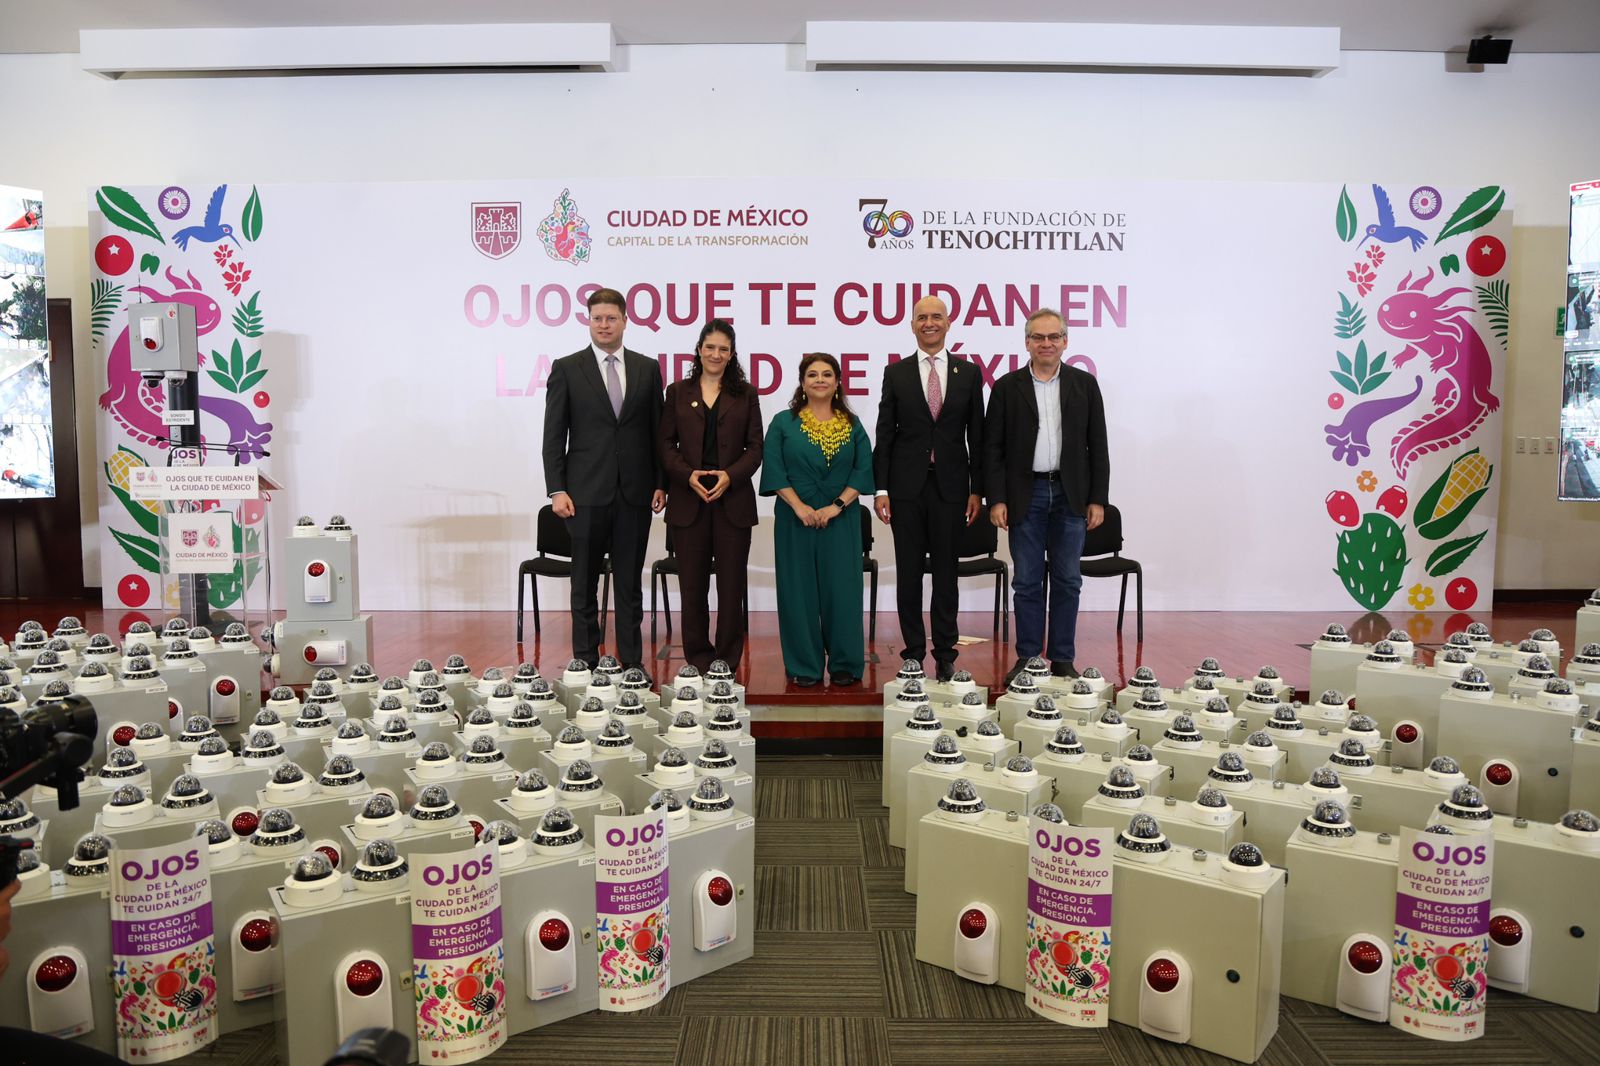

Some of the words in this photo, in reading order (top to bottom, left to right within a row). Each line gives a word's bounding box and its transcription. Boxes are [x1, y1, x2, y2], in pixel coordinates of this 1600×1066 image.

[607, 210, 687, 228] CIUDAD
[694, 209, 720, 226] DE
[727, 204, 808, 226] MÉXICO
[923, 210, 946, 225] DE
[953, 211, 975, 225] LA
[983, 210, 1096, 227] FUNDACIÓN
[1103, 213, 1126, 227] DE
[607, 235, 654, 246] CAPITAL
[658, 236, 674, 246] DE
[677, 236, 692, 246] LA
[695, 233, 808, 246] TRANSFORMACIÓN
[880, 238, 914, 249] AÑOS
[922, 230, 1126, 251] TENOCHTITLAN
[626, 283, 734, 332] QUE
[749, 283, 816, 325] TE
[1060, 284, 1127, 328] EN
[496, 354, 553, 397] LA
[172, 450, 196, 459] JOS
[606, 819, 663, 847] OJOS
[628, 848, 639, 856] DE
[642, 846, 652, 854] LA
[1036, 829, 1100, 857] OJOS
[635, 856, 646, 865] DE
[1052, 855, 1062, 864] DE
[1412, 841, 1486, 866] OJOS
[121, 849, 199, 881] OJOS
[423, 854, 492, 886] OJOS
[619, 864, 652, 875] CUIDAN
[1031, 856, 1056, 871] CIUDAD
[1058, 866, 1069, 875] DE
[1072, 869, 1108, 877] MÉXICO
[1436, 868, 1450, 876] DE
[147, 882, 161, 891] DE
[165, 880, 178, 888] LA
[628, 881, 652, 892] CASO
[1035, 868, 1043, 876] TE
[1044, 872, 1076, 885] CUIDAN
[1079, 879, 1101, 888] 24/7
[1402, 870, 1441, 884] CIUDAD
[1444, 878, 1458, 886] DE
[1461, 876, 1489, 886] MÉXICO
[114, 894, 152, 903] CIUDAD
[156, 891, 170, 900] DE
[174, 878, 207, 896] MÉXICO
[448, 888, 461, 896] DE
[464, 884, 476, 893] LA
[1038, 887, 1048, 896] EN
[1051, 892, 1076, 903] CASO
[1410, 881, 1422, 890] TE
[1425, 885, 1465, 896] CUIDAN
[1467, 887, 1484, 896] 24/7
[123, 905, 133, 913] TE
[137, 899, 179, 912] CUIDAN
[182, 891, 201, 904] 24/7
[415, 899, 453, 907] CIUDAD
[456, 896, 469, 905] DE
[438, 904, 476, 917] CUIDAN
[479, 895, 494, 909] 24/7
[618, 896, 660, 911] PRESIONA
[1036, 895, 1096, 915] EMERGENCIA,
[1416, 901, 1431, 911] EN
[1434, 905, 1464, 914] CASO
[1466, 905, 1478, 914] DE
[131, 923, 145, 932] EN
[148, 918, 180, 930] CASO
[183, 912, 196, 923] DE
[1042, 907, 1087, 923] PRESIONA
[127, 922, 200, 942] EMERGENCIA,
[432, 928, 446, 936] EN
[449, 922, 478, 935] CASO
[480, 916, 490, 927] DE
[1420, 922, 1473, 934] PRESIONA
[137, 934, 192, 952] PRESIONA
[438, 939, 488, 956] PRESIONA
